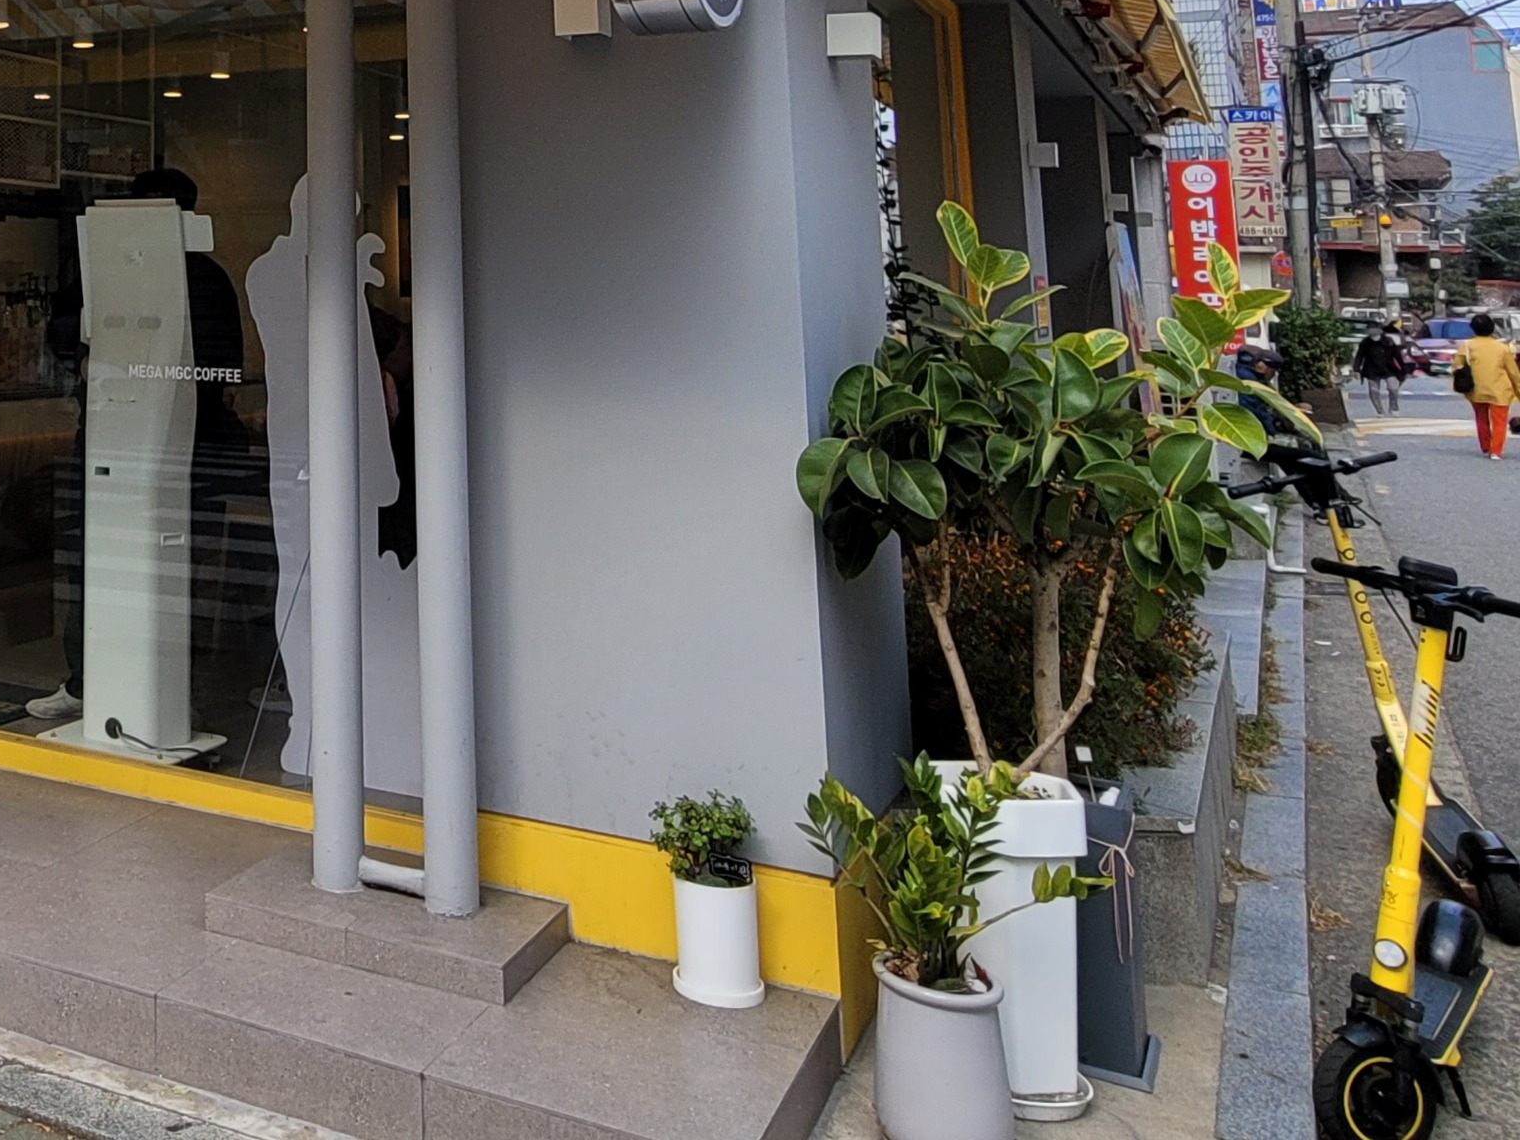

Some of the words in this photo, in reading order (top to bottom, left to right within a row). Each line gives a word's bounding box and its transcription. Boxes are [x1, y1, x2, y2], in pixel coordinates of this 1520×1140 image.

[1232, 111, 1273, 122] 스카이
[1234, 126, 1278, 223] 공인중개사
[128, 364, 163, 379] MEGA
[164, 365, 192, 380] MGC
[193, 367, 242, 383] COFFEE
